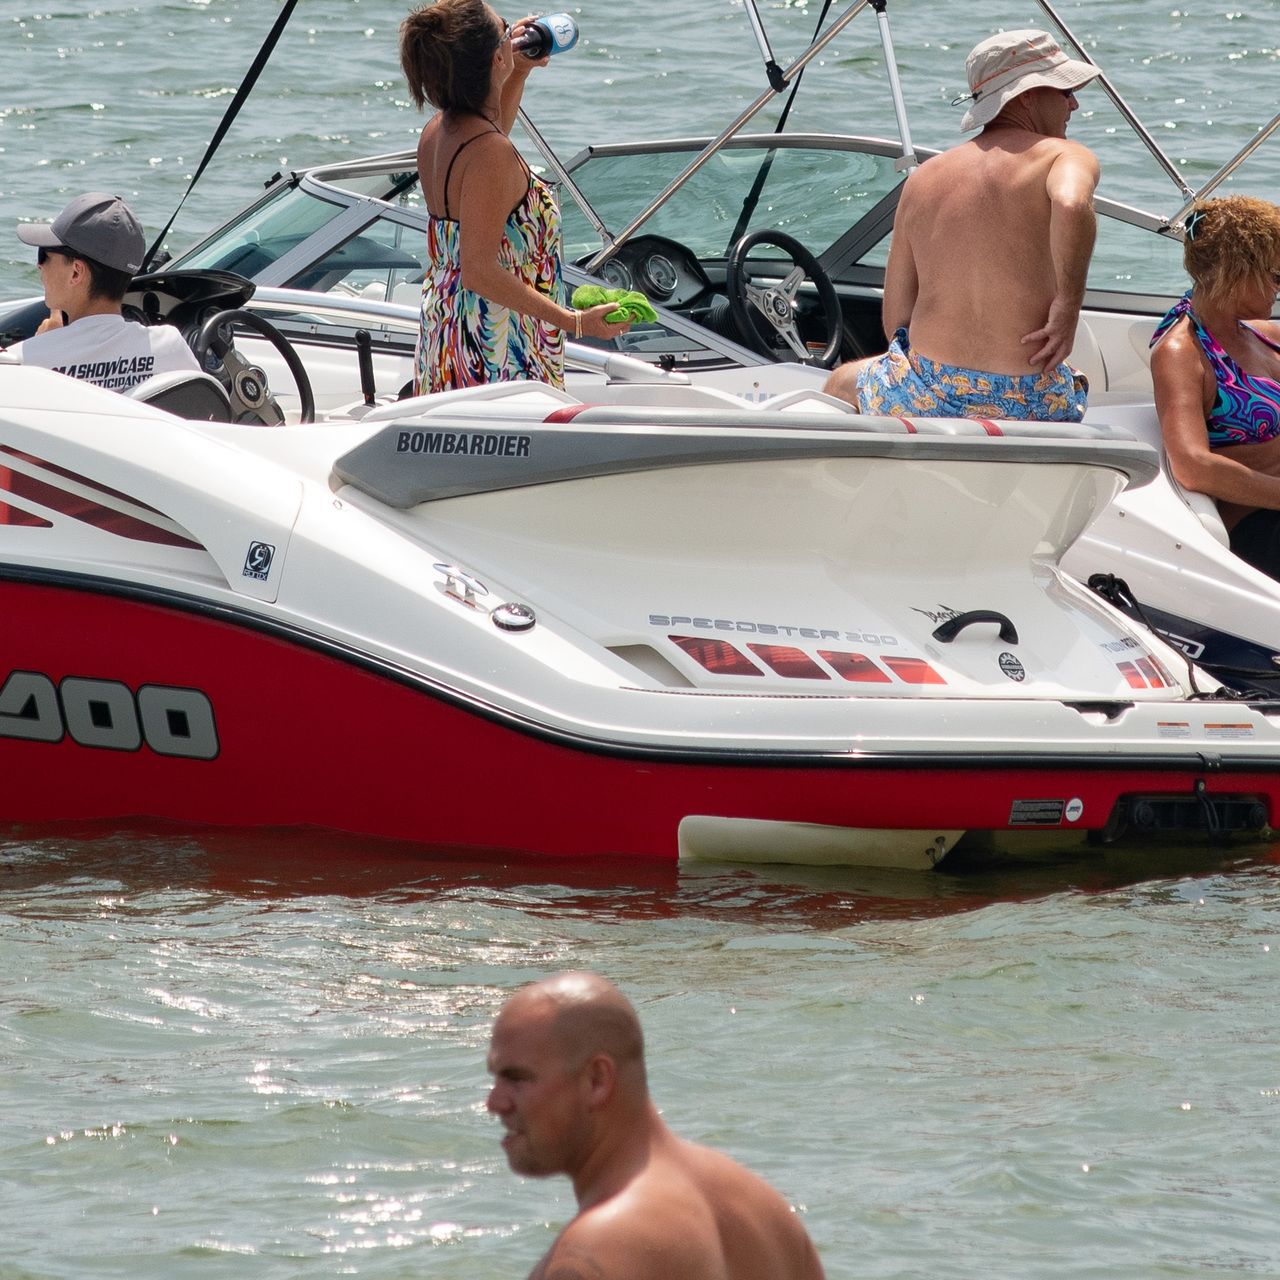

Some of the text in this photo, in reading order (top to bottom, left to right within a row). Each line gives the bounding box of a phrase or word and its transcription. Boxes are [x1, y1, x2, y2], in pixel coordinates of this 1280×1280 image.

[395, 431, 532, 457] BOMBARDIER
[648, 614, 899, 647] SPEEDSTER 200
